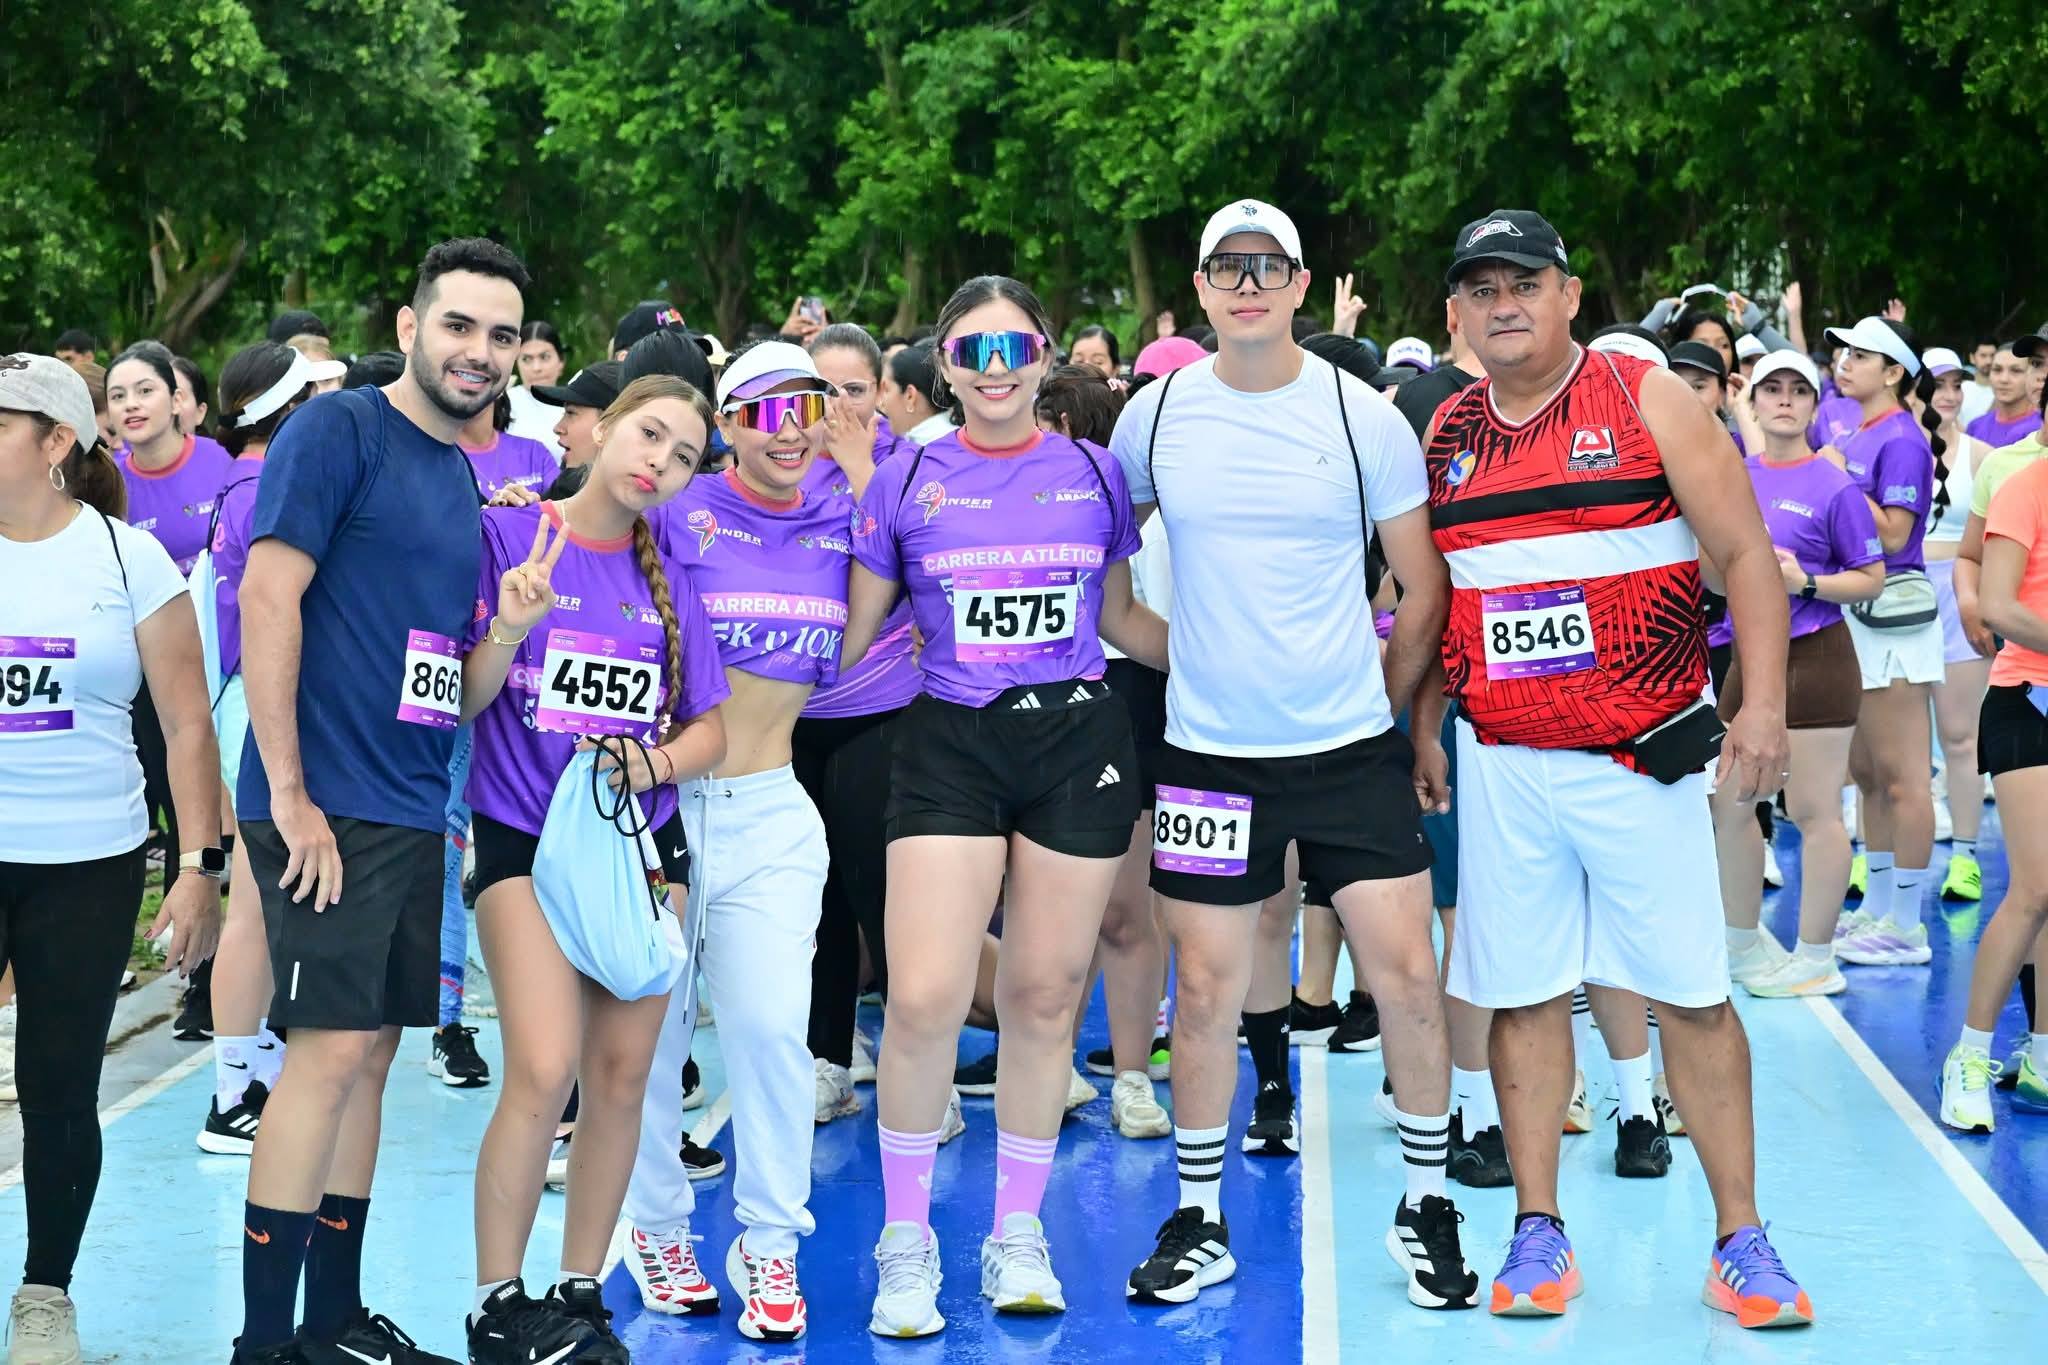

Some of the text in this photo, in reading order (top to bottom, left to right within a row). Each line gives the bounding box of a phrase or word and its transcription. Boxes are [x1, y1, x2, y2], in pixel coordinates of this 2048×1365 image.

[941, 497, 992, 506] INDER
[716, 527, 761, 545] INDER
[924, 544, 1104, 572] CARRERA ATLÉTICA
[795, 599, 848, 625] ATLÉTIC
[965, 593, 1067, 638] 4575
[1491, 613, 1585, 655] 8546
[0, 664, 62, 707] 94
[411, 661, 462, 706] 866
[551, 658, 652, 715] 4552
[1156, 810, 1237, 851] 8901
[497, 1285, 518, 1301] DIESEL
[574, 1281, 595, 1289] DIESEL
